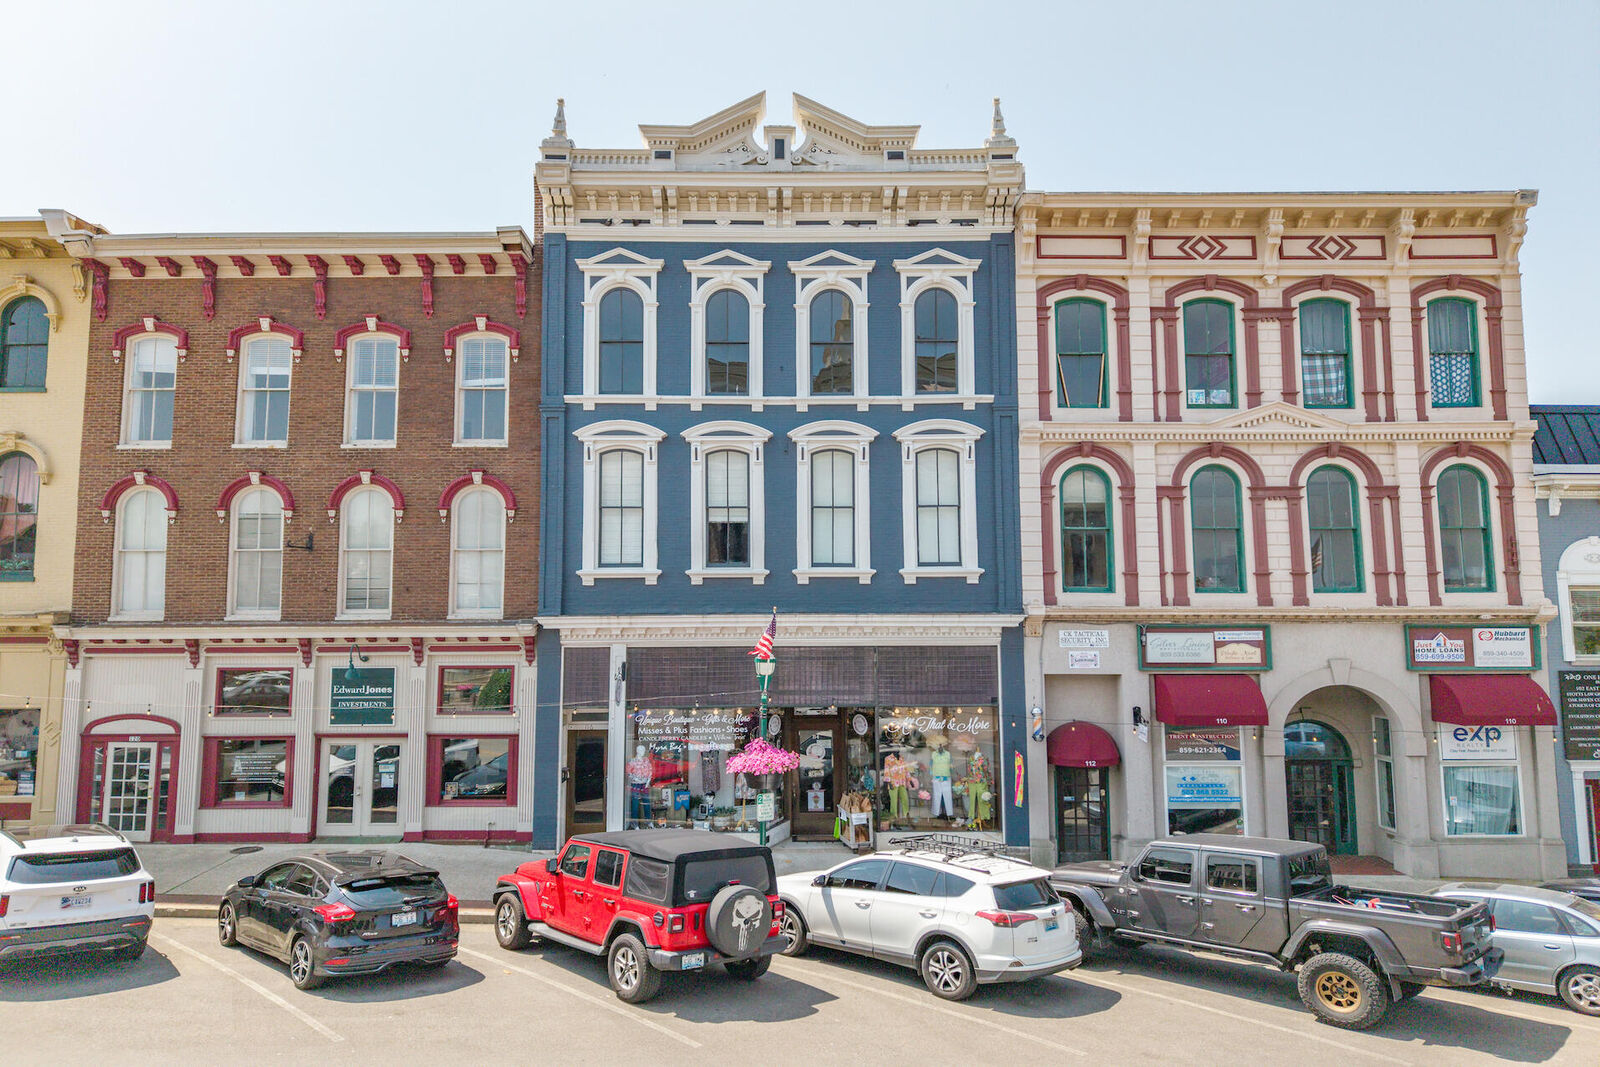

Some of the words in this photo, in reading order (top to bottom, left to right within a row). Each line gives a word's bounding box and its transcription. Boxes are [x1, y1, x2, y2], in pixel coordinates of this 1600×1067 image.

[333, 685, 365, 694] Edward
[365, 685, 393, 695] Jones
[635, 713, 662, 725] Unique
[663, 713, 695, 725] Boutique
[701, 713, 721, 725] Gifts
[721, 714, 728, 723] &
[637, 726, 663, 735] Misses
[664, 726, 672, 734] &
[673, 726, 688, 734] Plus
[689, 726, 721, 734] Fashions
[726, 725, 749, 733] Shoes
[915, 716, 946, 733] That
[947, 718, 956, 731] &
[956, 715, 991, 735] More
[648, 742, 668, 752] Myra
[669, 742, 683, 753] Bag
